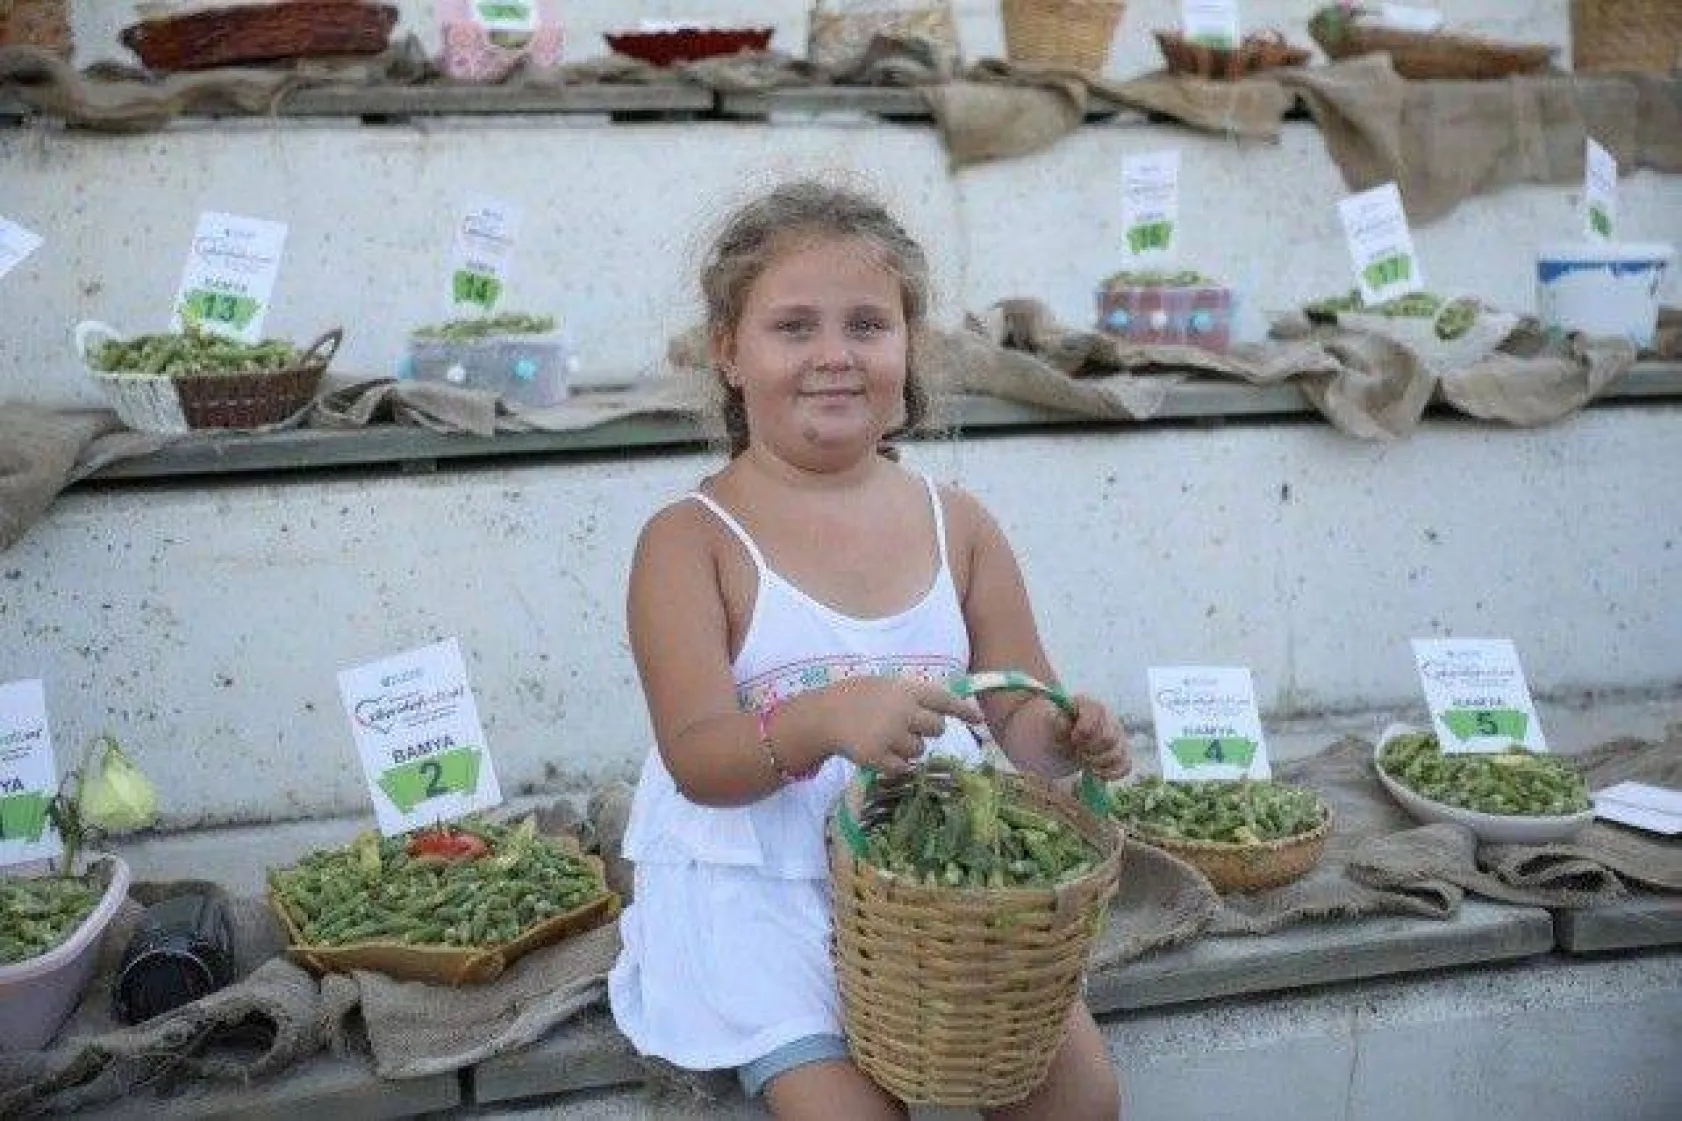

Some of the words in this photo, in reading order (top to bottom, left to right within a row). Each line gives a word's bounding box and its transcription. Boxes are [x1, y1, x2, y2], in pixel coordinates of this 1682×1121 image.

[202, 294, 238, 323] 13
[1476, 712, 1499, 735] 5
[391, 736, 455, 764] BAMYA
[1204, 739, 1224, 763] 4
[420, 762, 449, 797] 2
